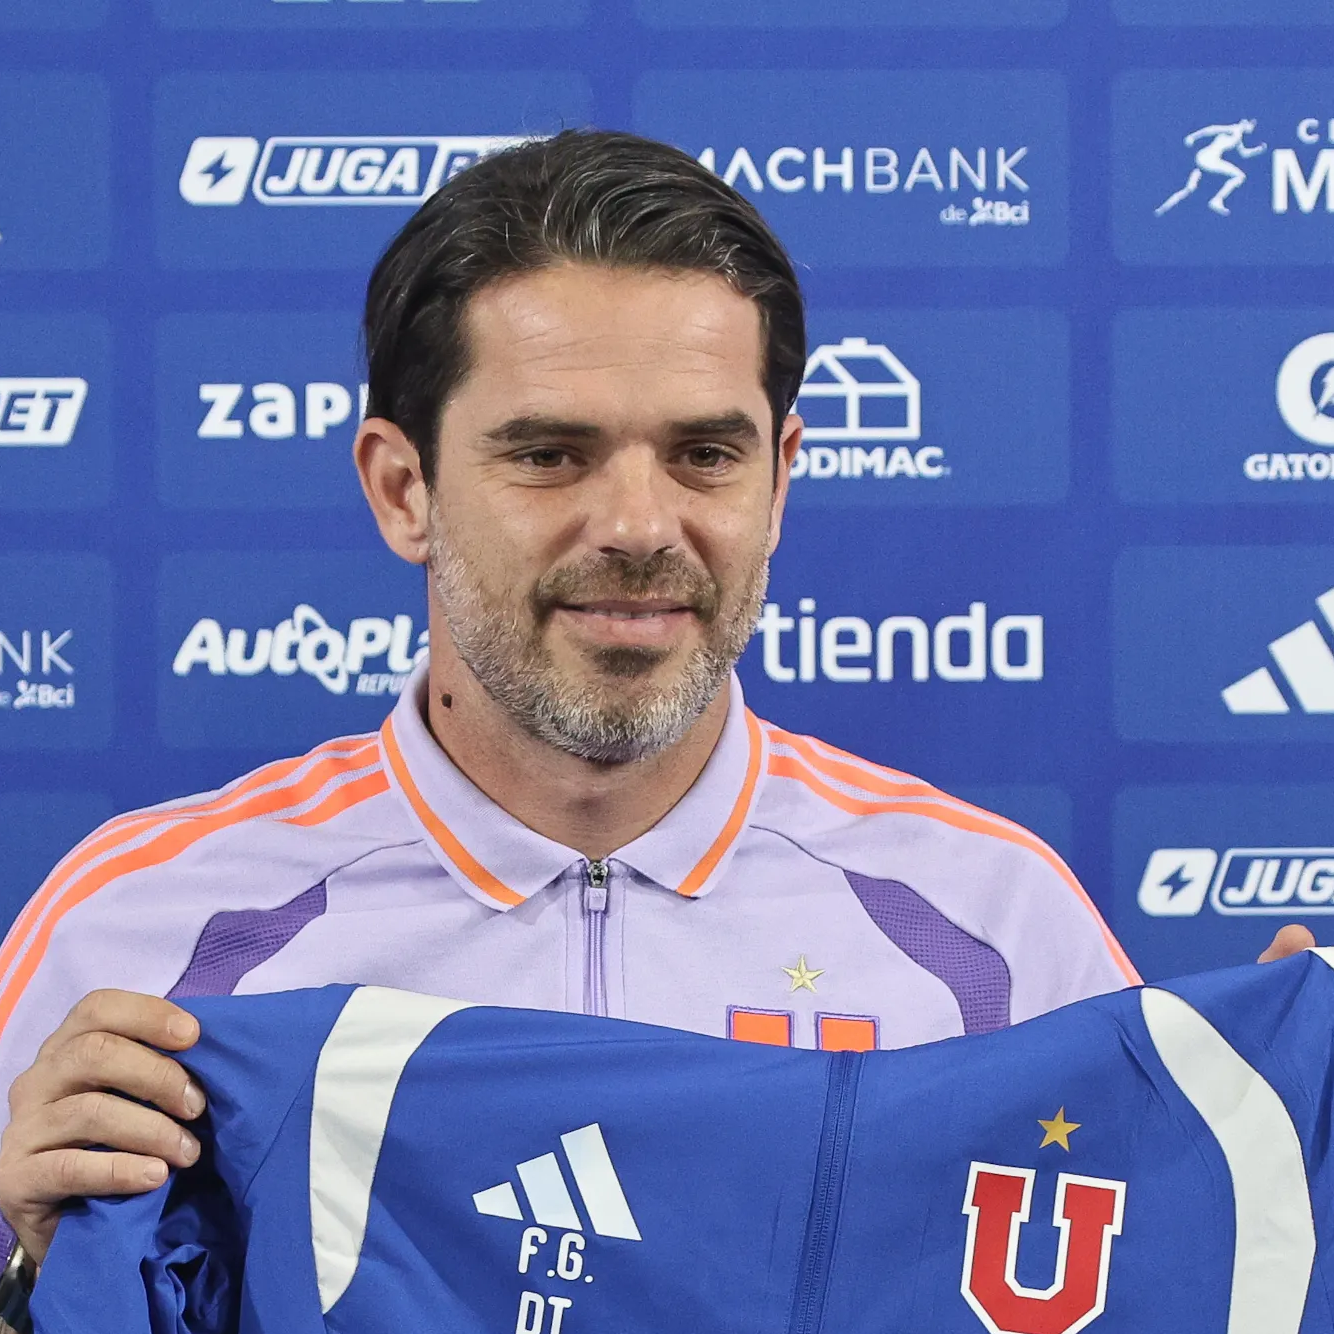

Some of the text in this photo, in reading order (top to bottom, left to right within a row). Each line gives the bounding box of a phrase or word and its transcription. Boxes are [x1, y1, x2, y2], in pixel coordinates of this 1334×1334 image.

[265, 147, 479, 194] JUGA
[172, 603, 429, 694] AutoPl
[757, 597, 1043, 682] tienda
